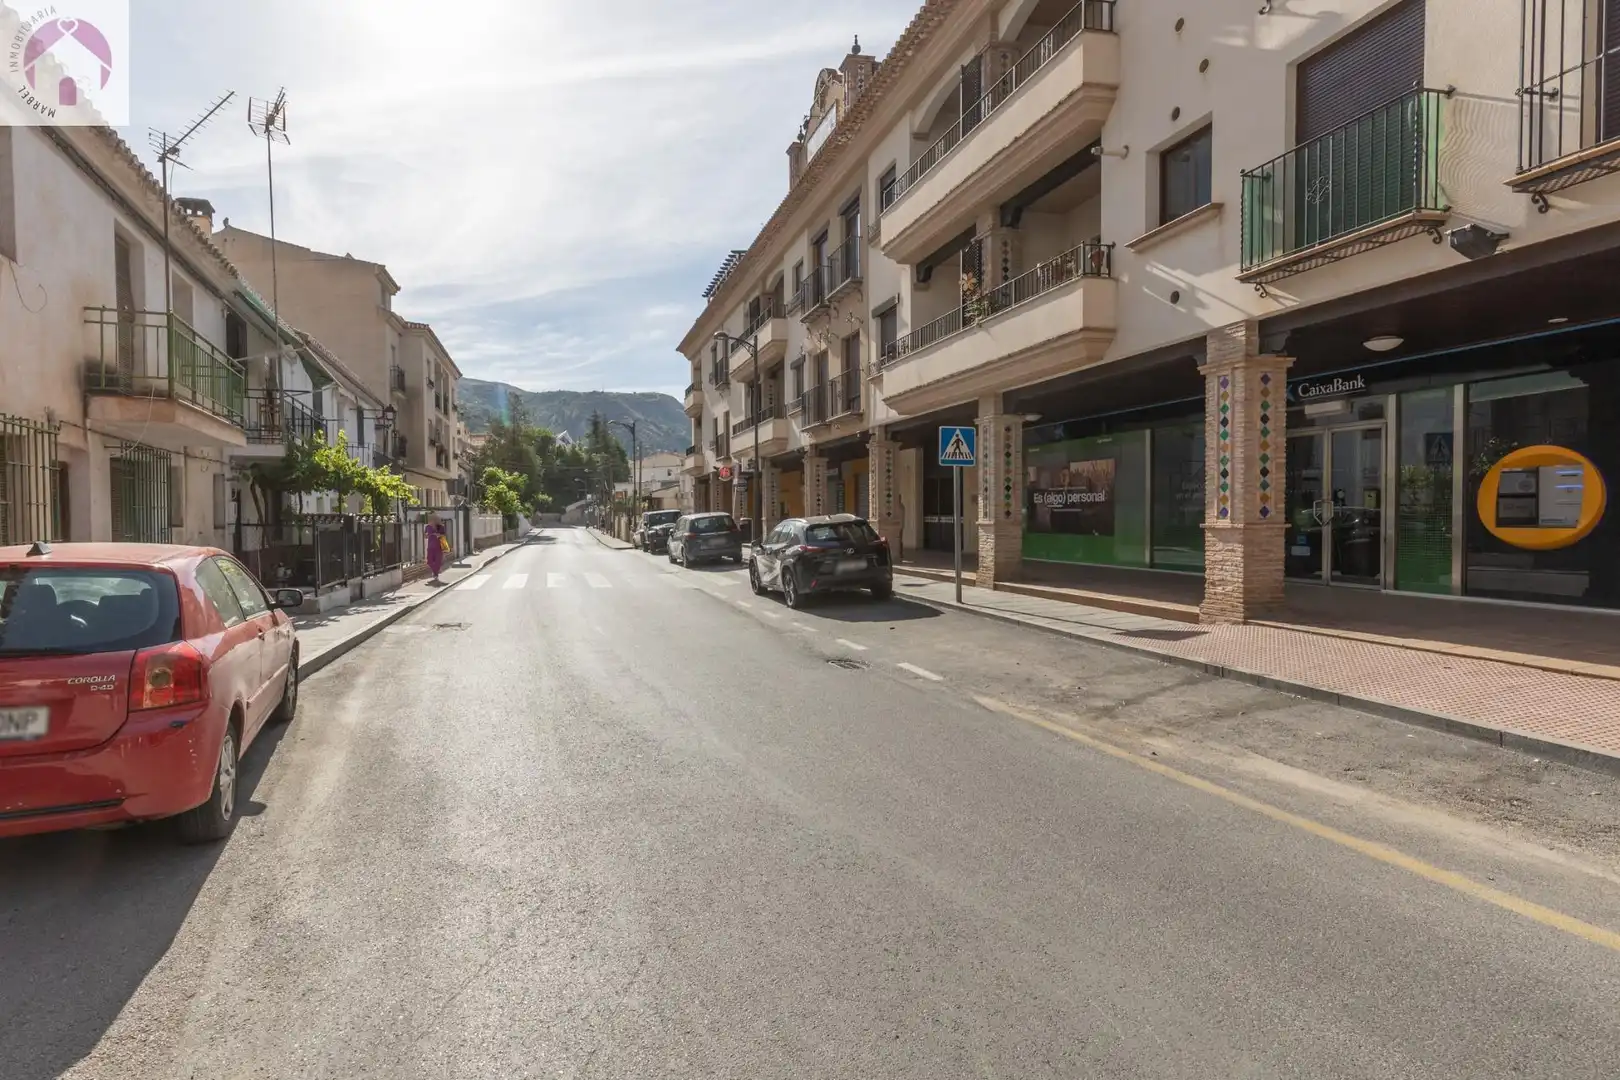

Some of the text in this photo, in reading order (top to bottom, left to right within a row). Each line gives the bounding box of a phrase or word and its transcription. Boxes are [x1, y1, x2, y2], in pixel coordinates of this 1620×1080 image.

[1298, 374, 1366, 398] CaixaBank
[1033, 489, 1105, 505] Es (algo) personal
[67, 674, 116, 685] COROLLA
